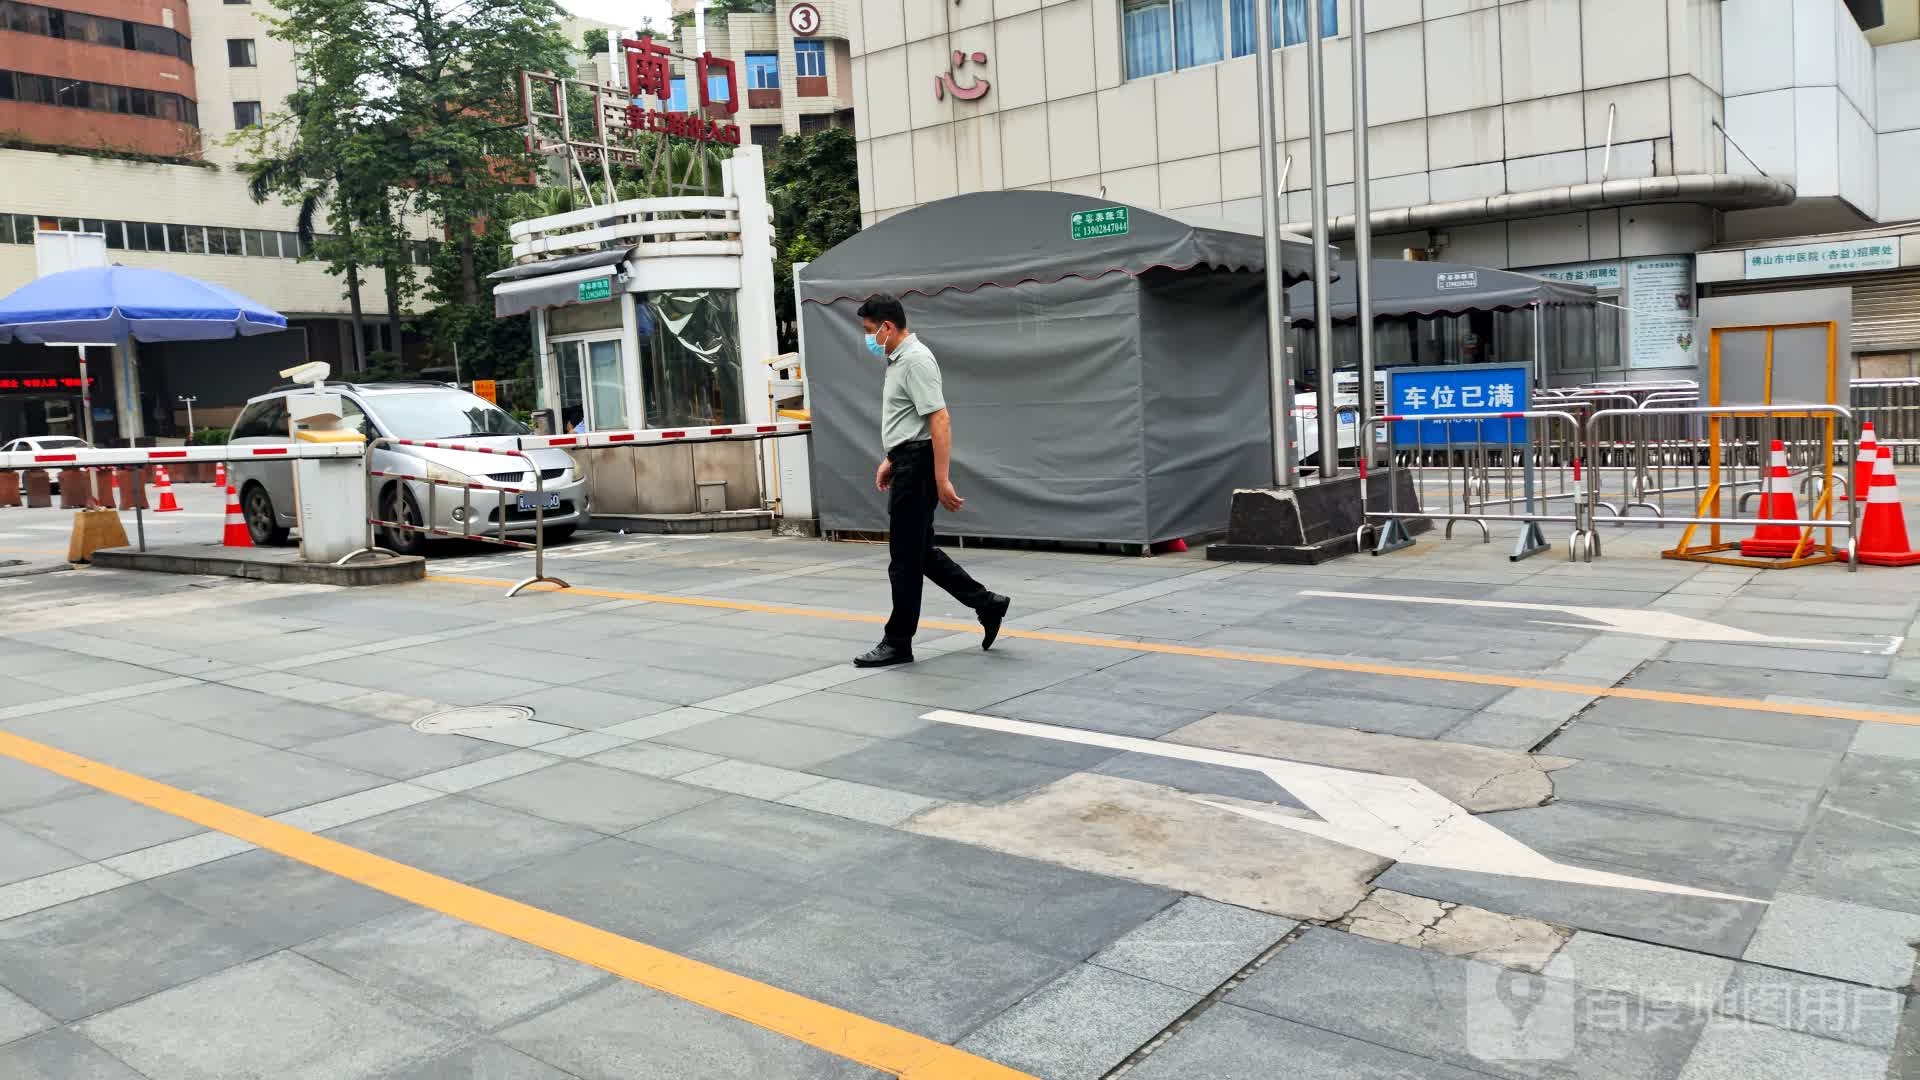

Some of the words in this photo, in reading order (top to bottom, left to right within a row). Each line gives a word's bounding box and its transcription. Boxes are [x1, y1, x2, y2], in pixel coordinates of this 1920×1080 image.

[798, 9, 812, 30] 3
[622, 35, 740, 114] 南门
[935, 49, 991, 102] 心
[1403, 383, 1515, 410] 车位已满
